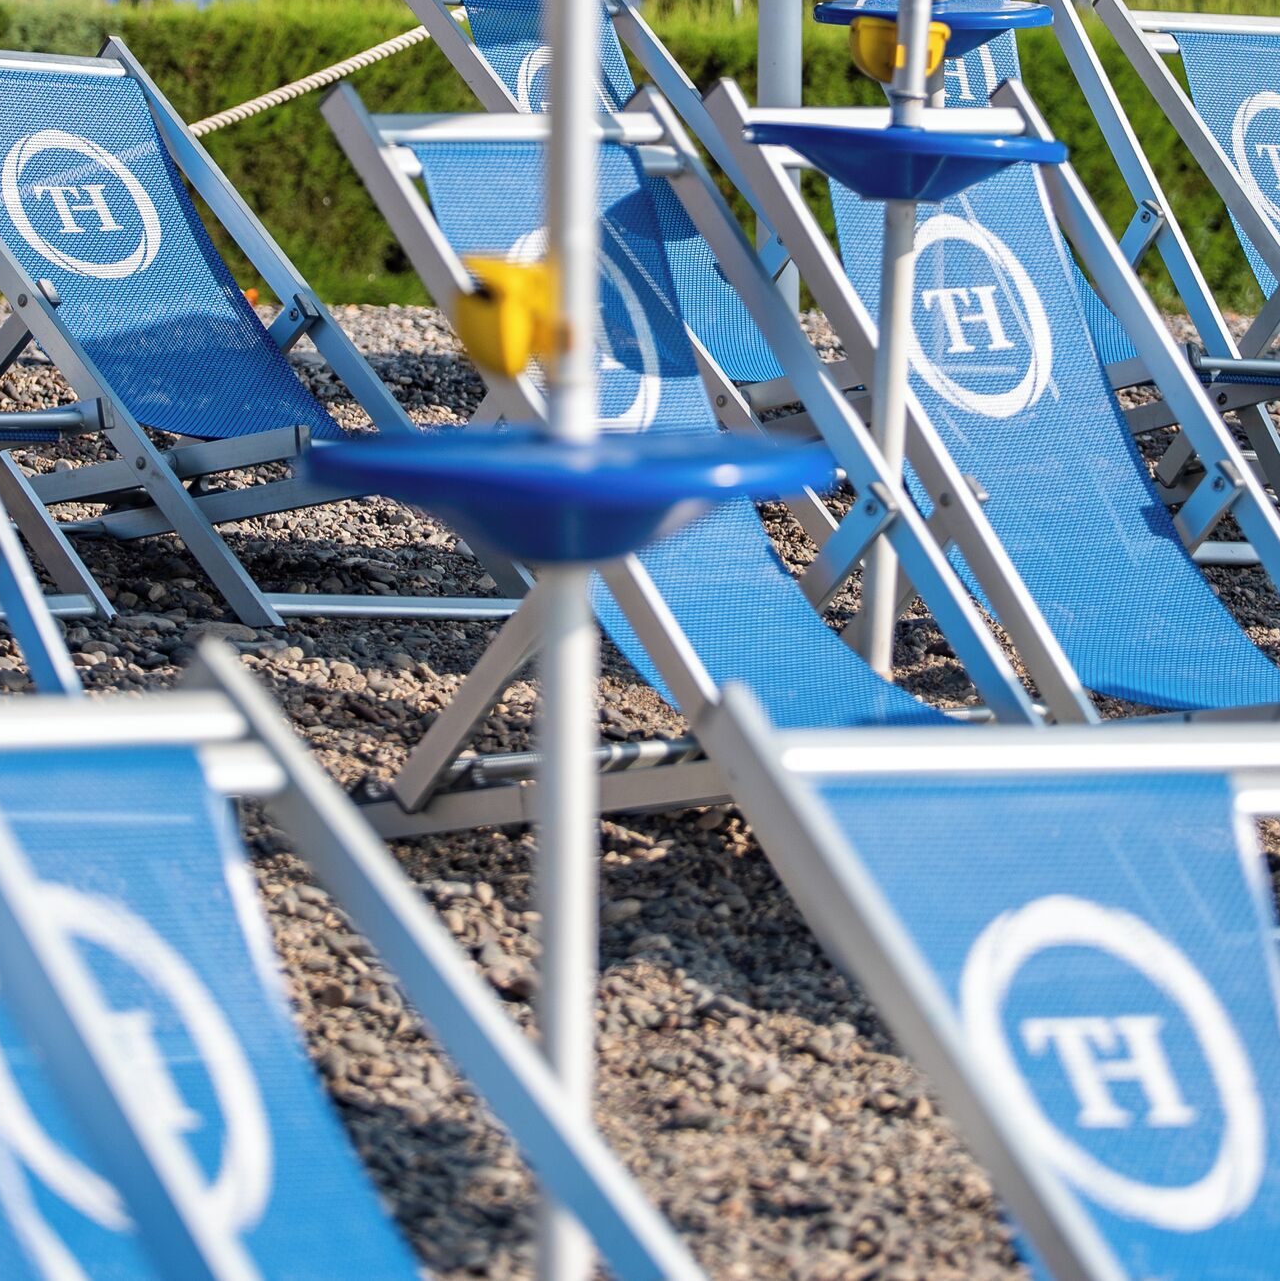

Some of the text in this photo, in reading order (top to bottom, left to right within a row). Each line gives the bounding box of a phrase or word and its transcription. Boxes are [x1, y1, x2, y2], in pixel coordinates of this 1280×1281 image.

[33, 184, 124, 232] TH
[921, 285, 1015, 353] TH
[1020, 1015, 1195, 1128] TH
